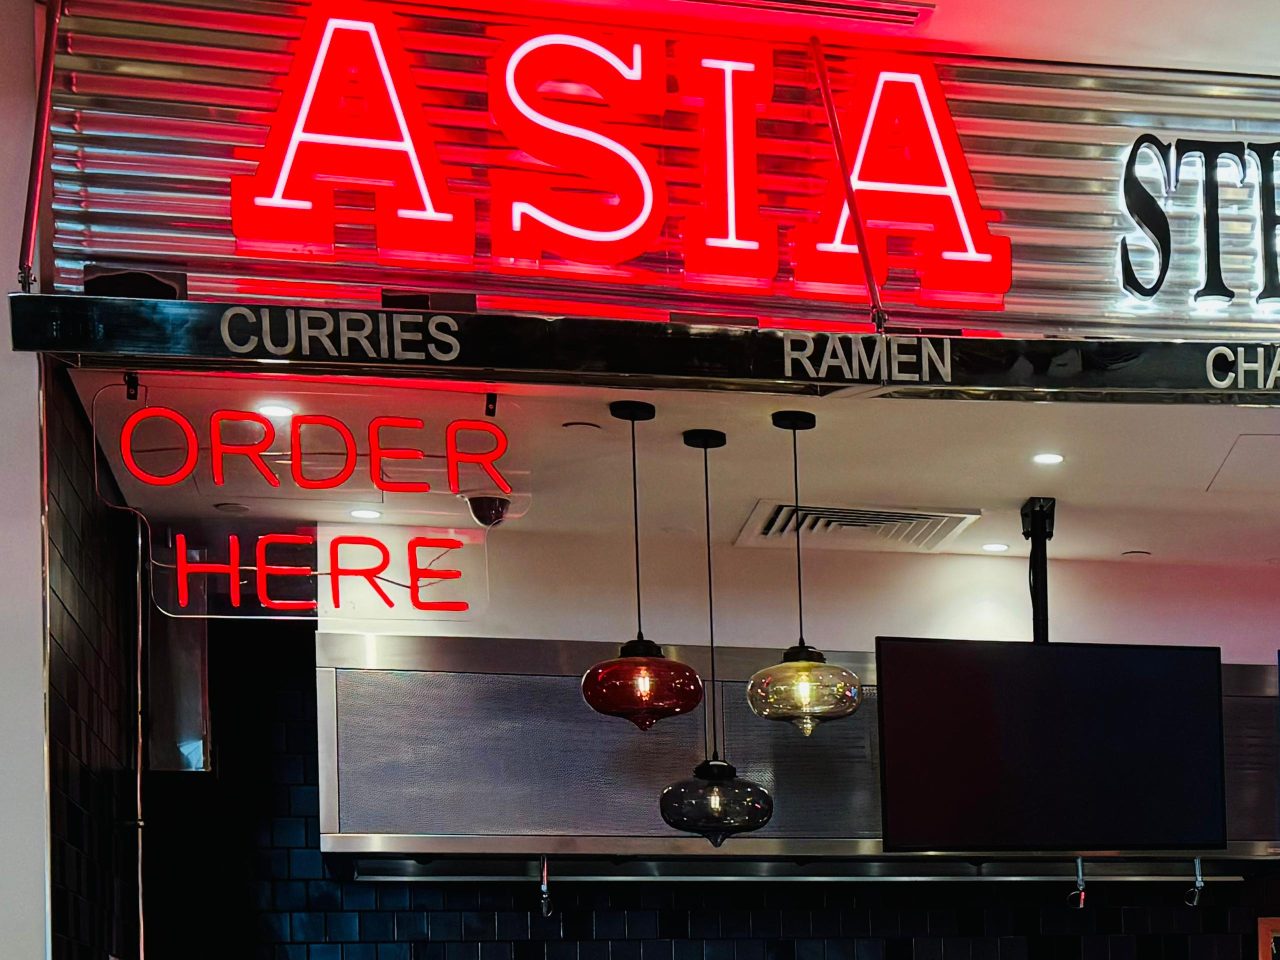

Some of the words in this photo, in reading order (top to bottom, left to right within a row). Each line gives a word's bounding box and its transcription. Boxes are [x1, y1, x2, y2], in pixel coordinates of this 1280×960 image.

[254, 18, 993, 262] ASIA
[220, 306, 461, 361] CURRIES
[782, 333, 952, 383] RAMEN
[121, 407, 512, 494] ORDER
[176, 533, 469, 612] HERE
